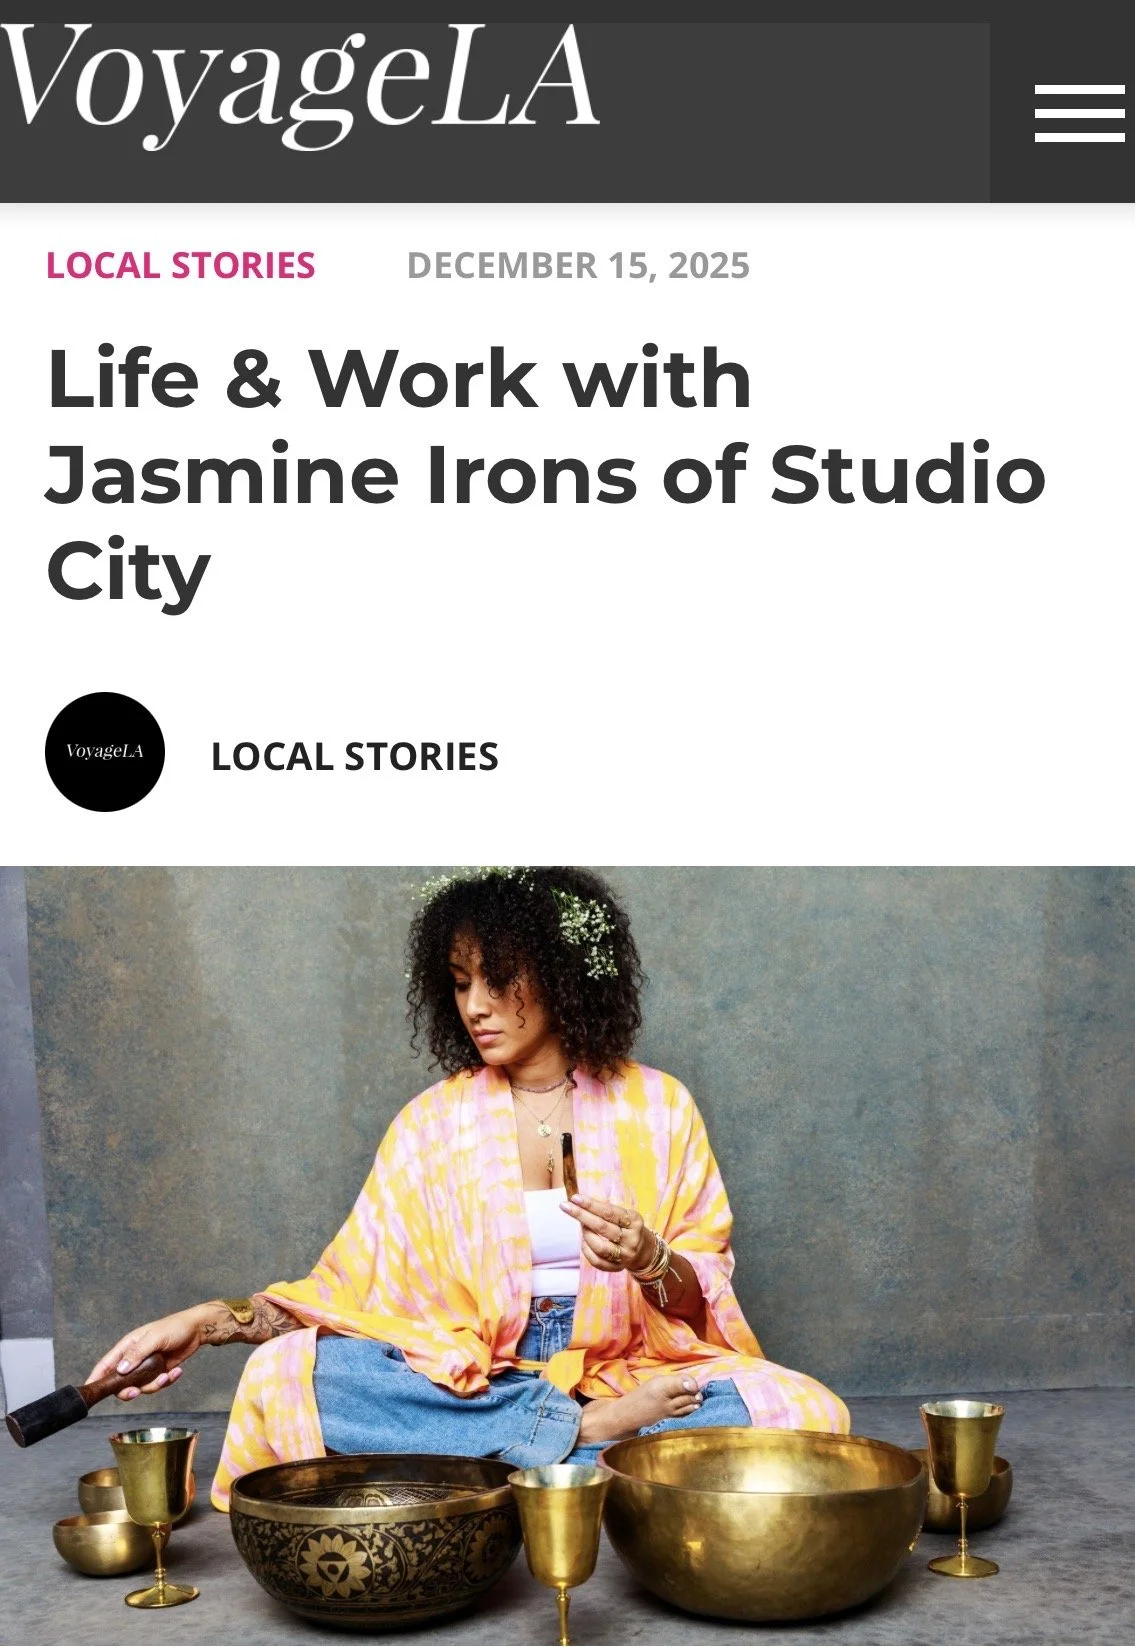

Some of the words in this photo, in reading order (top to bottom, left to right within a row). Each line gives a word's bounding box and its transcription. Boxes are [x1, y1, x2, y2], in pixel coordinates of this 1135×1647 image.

[0, 23, 601, 152] VoyageLA
[47, 251, 161, 279] LOCAL
[171, 251, 316, 280] STORIES
[408, 251, 598, 279] DECEMBER
[609, 251, 657, 284] 15,
[668, 251, 750, 279] 2025
[51, 342, 199, 409] Life
[226, 348, 282, 409] &
[307, 345, 540, 409] Work
[561, 342, 750, 409] with
[44, 438, 399, 505] Jasmine
[430, 445, 637, 505] Irons
[663, 438, 750, 505] of
[770, 438, 1046, 505] Studio
[47, 534, 212, 617] City
[66, 743, 144, 761] VoyageLA
[212, 741, 335, 772] LOCAL
[345, 741, 499, 772] STORIES
